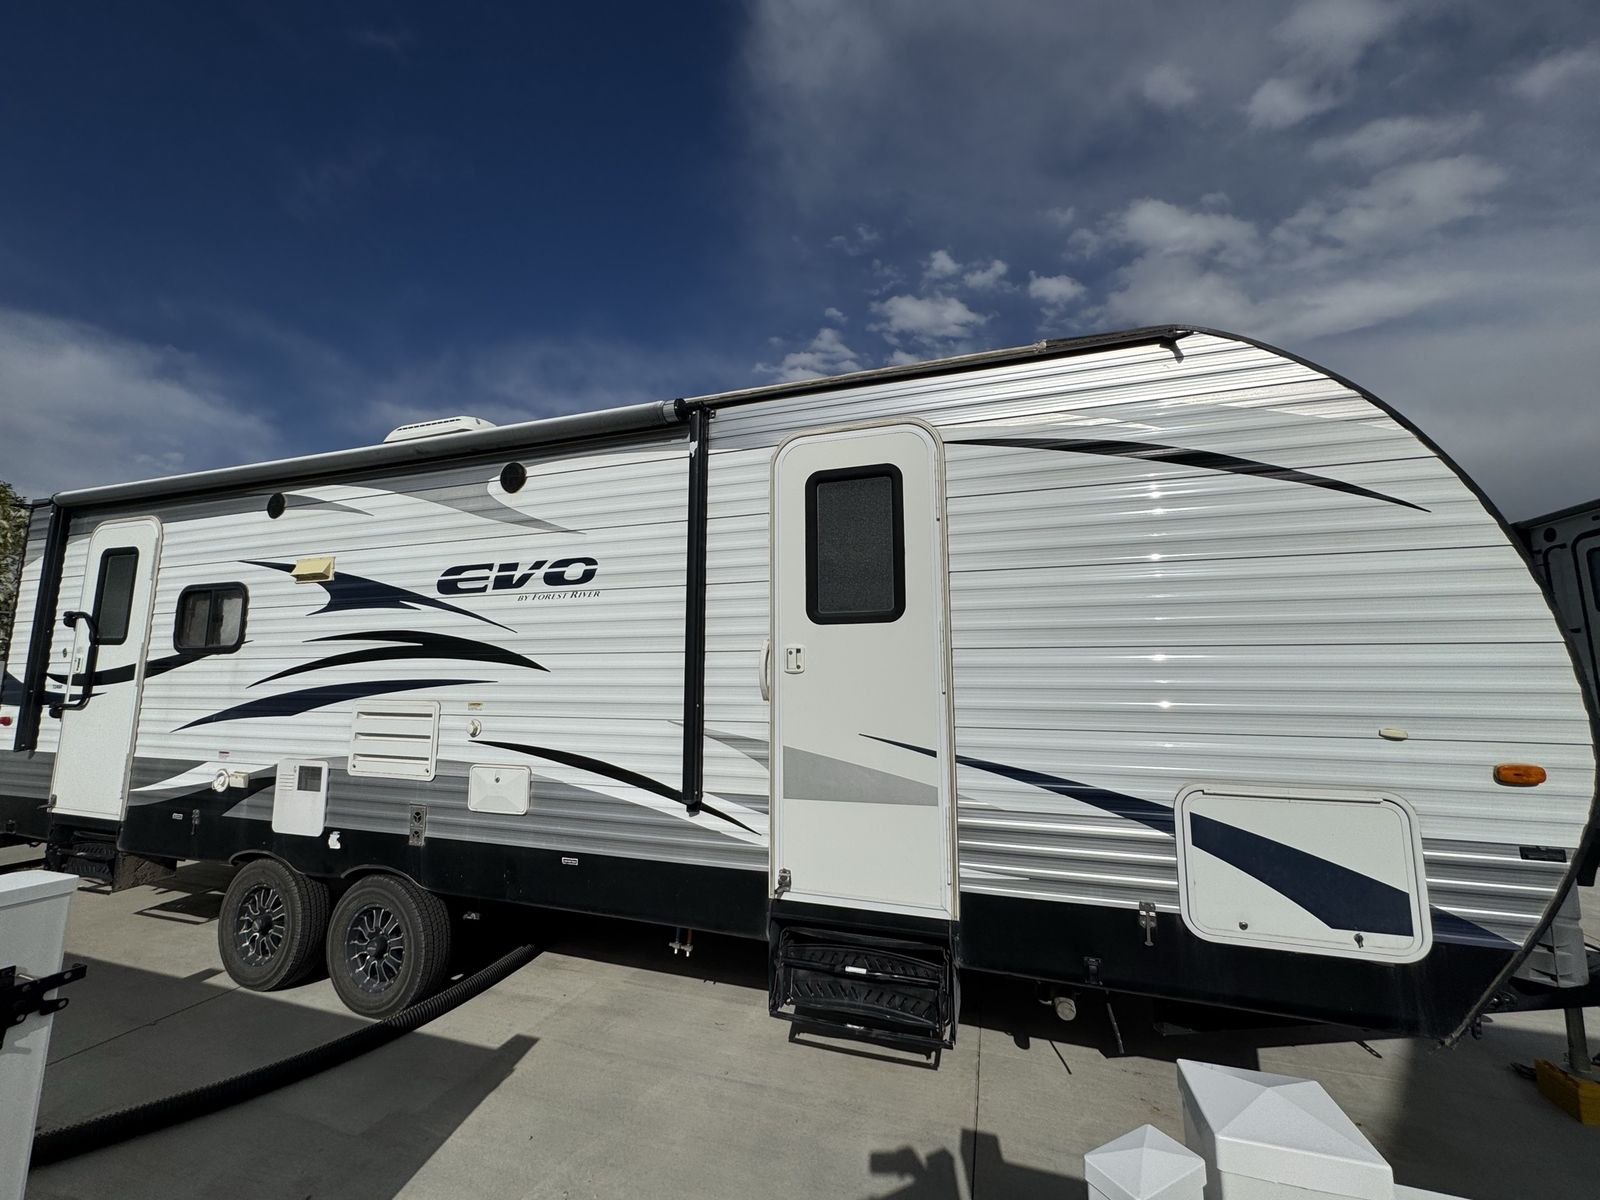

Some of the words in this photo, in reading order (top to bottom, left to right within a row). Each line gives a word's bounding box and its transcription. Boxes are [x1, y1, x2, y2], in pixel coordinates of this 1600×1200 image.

[436, 556, 599, 596] EVO
[531, 592, 568, 600] FOREST
[570, 590, 601, 599] RIVER
